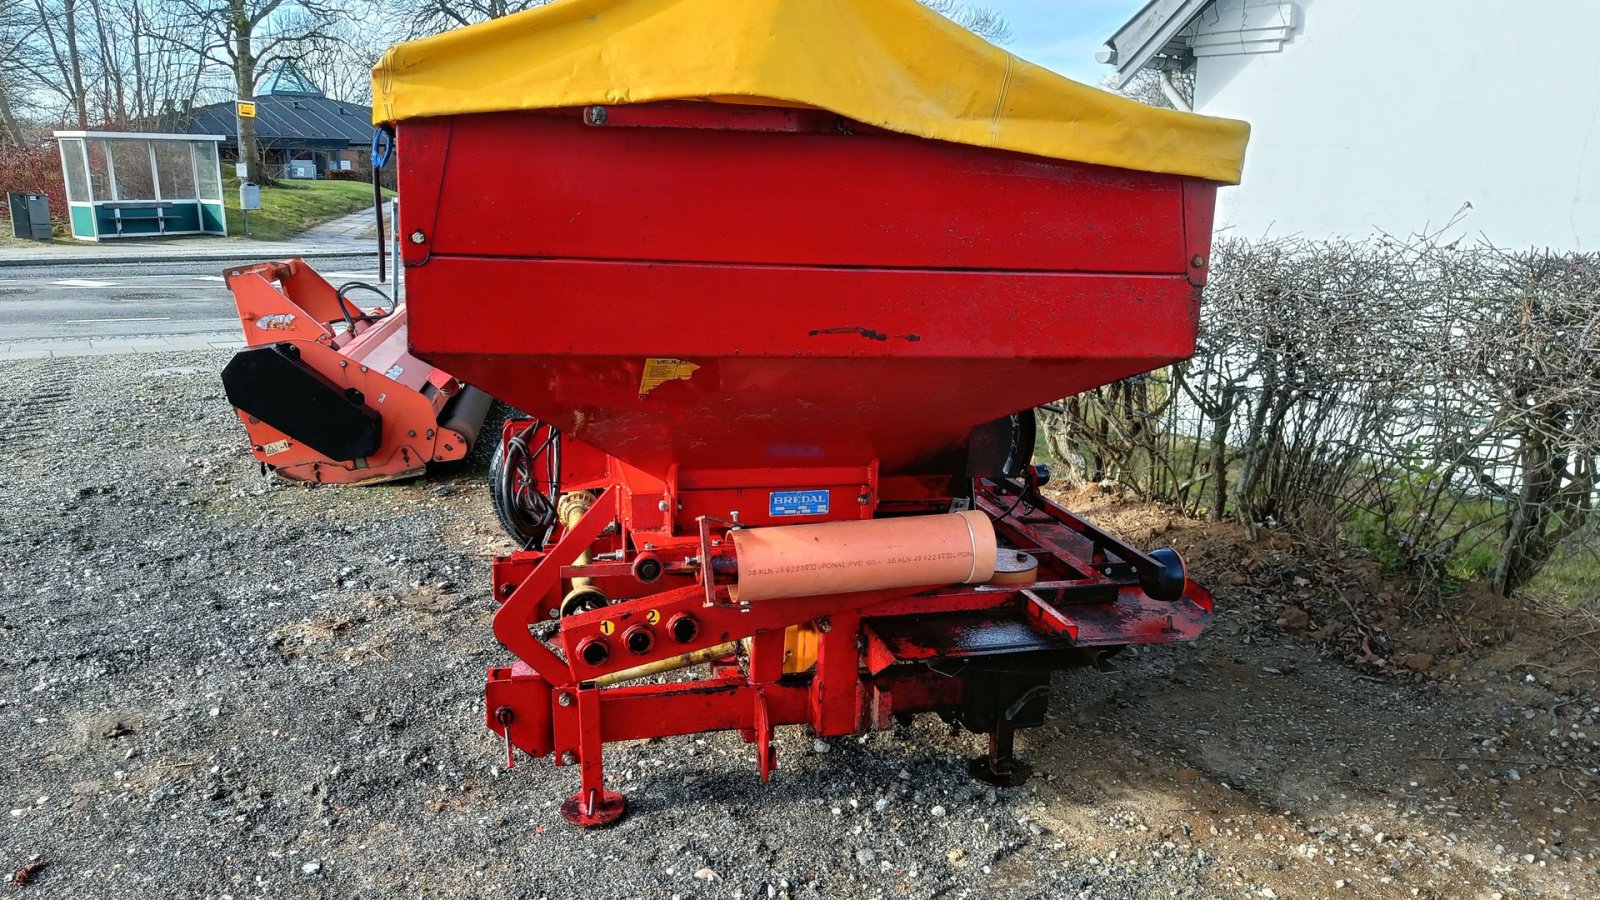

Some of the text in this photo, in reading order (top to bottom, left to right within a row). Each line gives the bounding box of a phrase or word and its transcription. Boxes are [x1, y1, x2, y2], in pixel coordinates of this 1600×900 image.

[773, 495, 826, 505] BREDAL
[848, 560, 863, 568] PVC
[648, 610, 657, 623] 2
[601, 620, 609, 634] 1
